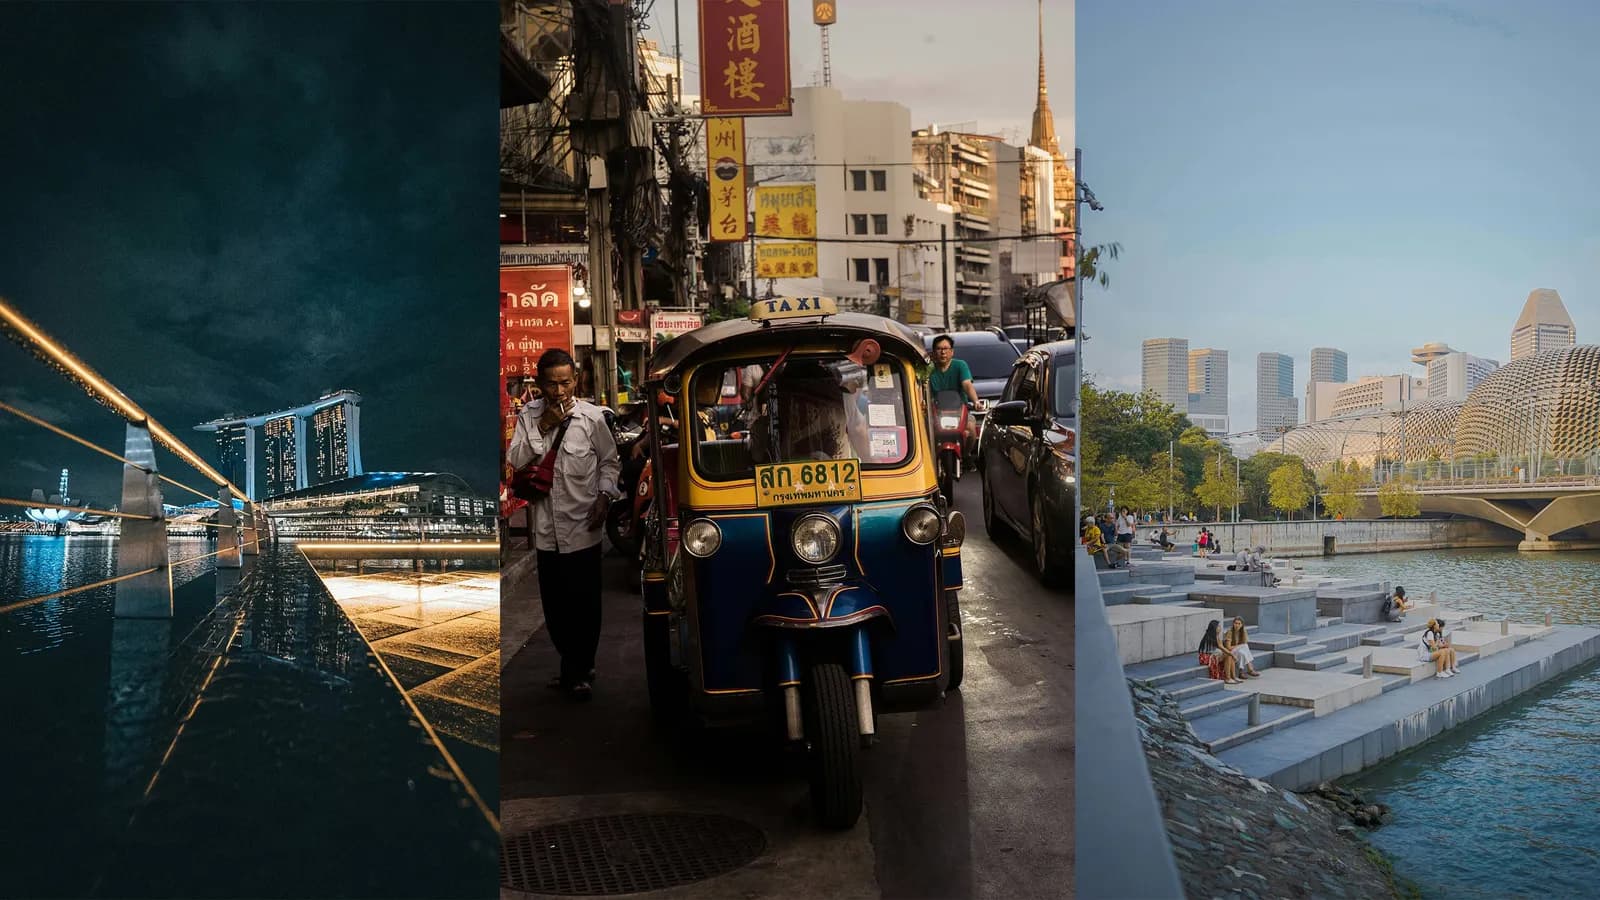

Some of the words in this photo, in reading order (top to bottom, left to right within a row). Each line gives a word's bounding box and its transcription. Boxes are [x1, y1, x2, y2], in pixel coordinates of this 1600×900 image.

[765, 297, 821, 312] TAXI
[760, 465, 792, 489] สก
[801, 463, 856, 485] 6812
[773, 488, 845, 504] กรุงเทพมหานคร
